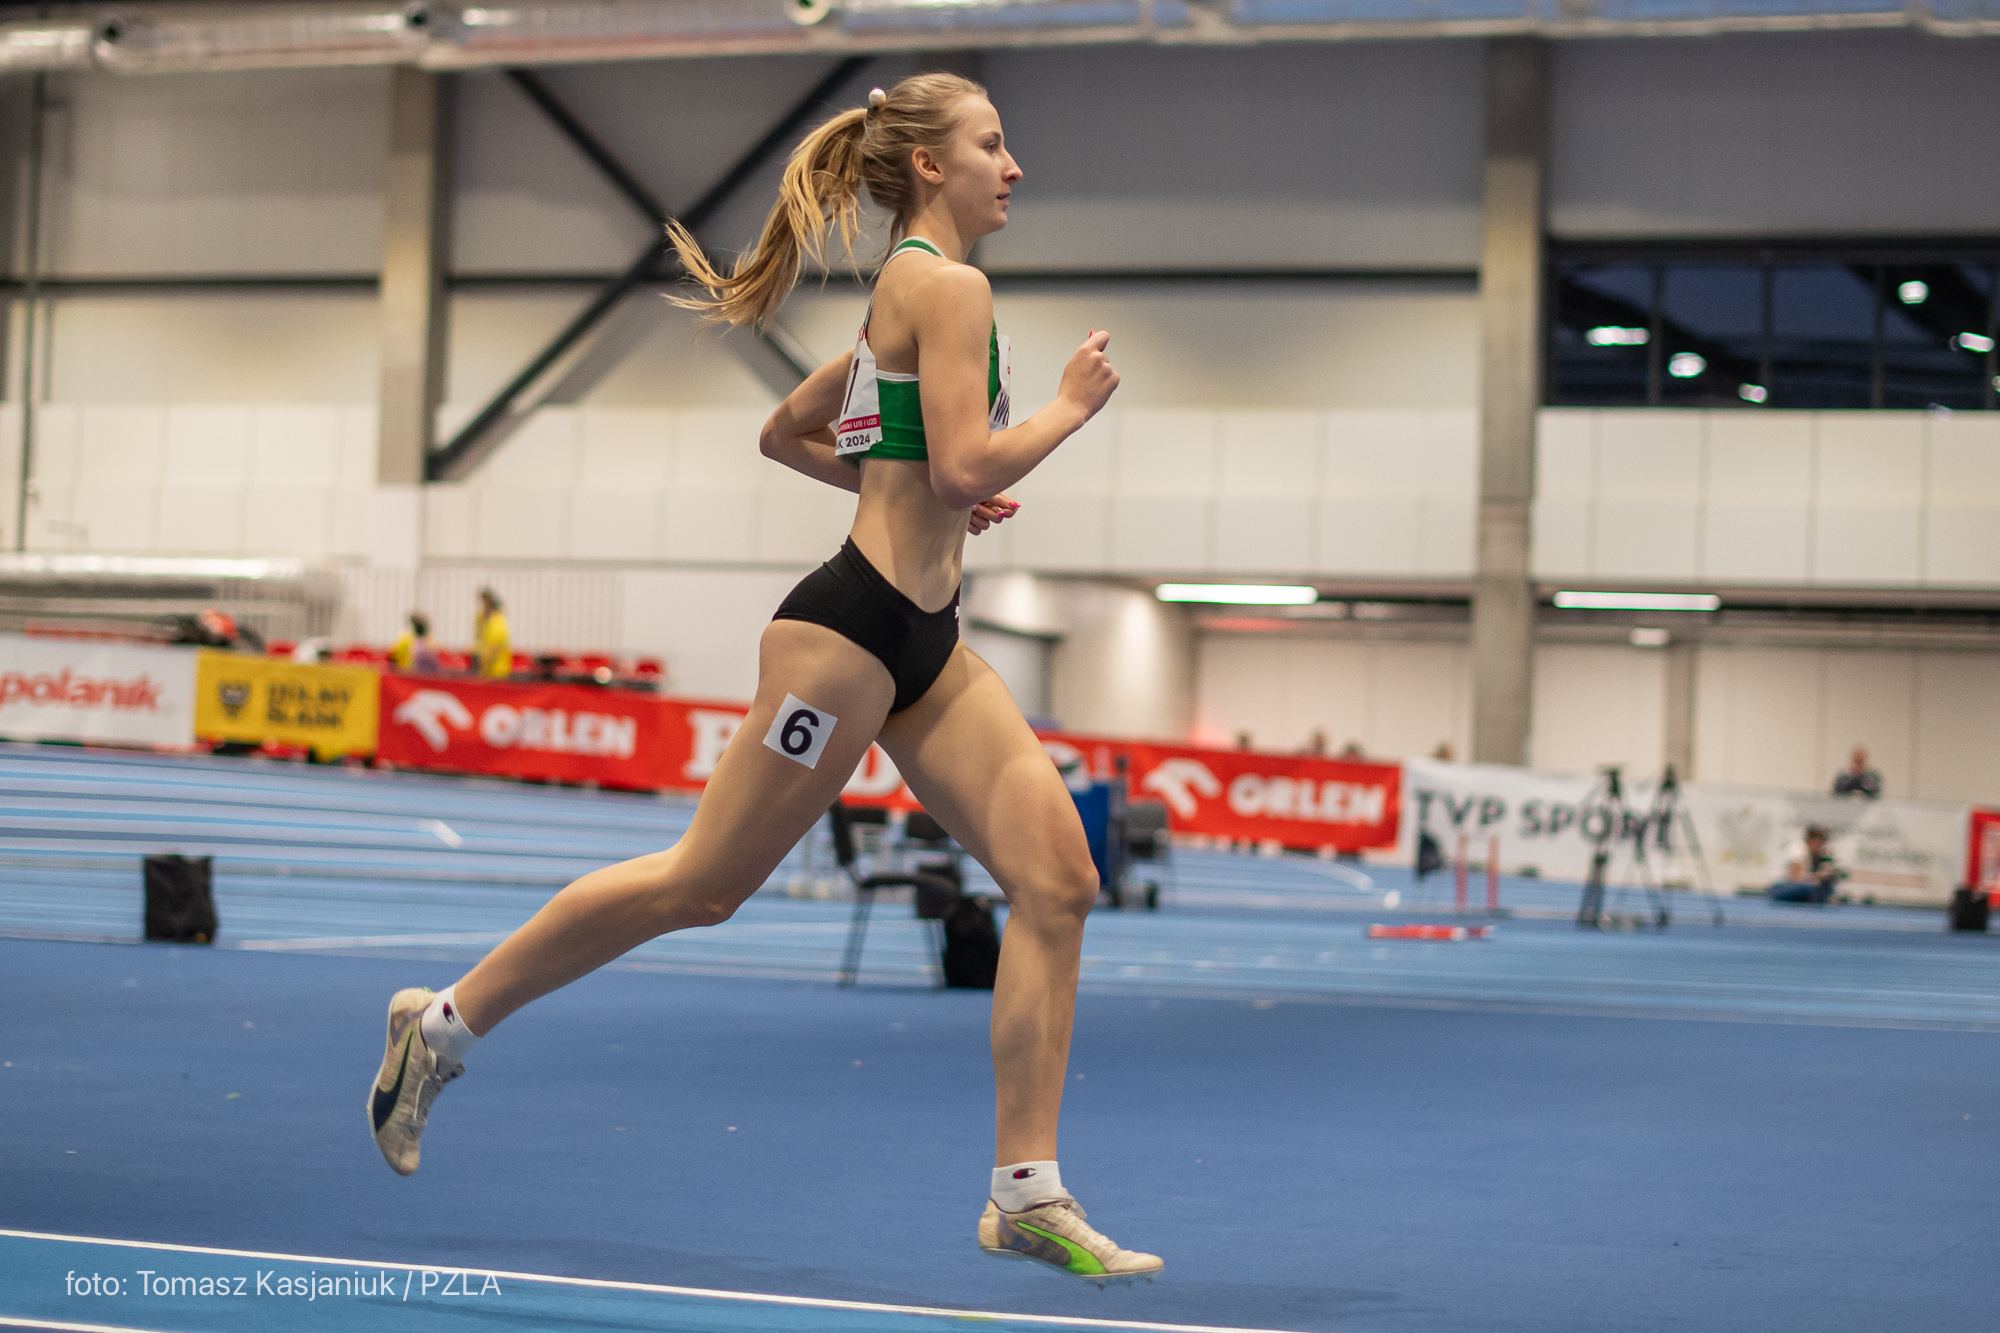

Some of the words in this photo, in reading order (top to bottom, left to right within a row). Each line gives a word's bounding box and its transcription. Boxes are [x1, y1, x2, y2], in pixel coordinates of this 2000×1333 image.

[845, 433, 870, 448] 2024
[480, 703, 637, 759] ORLEN
[780, 708, 820, 756] 6
[1228, 773, 1386, 826] ORLEN
[1414, 789, 1507, 827] TVP
